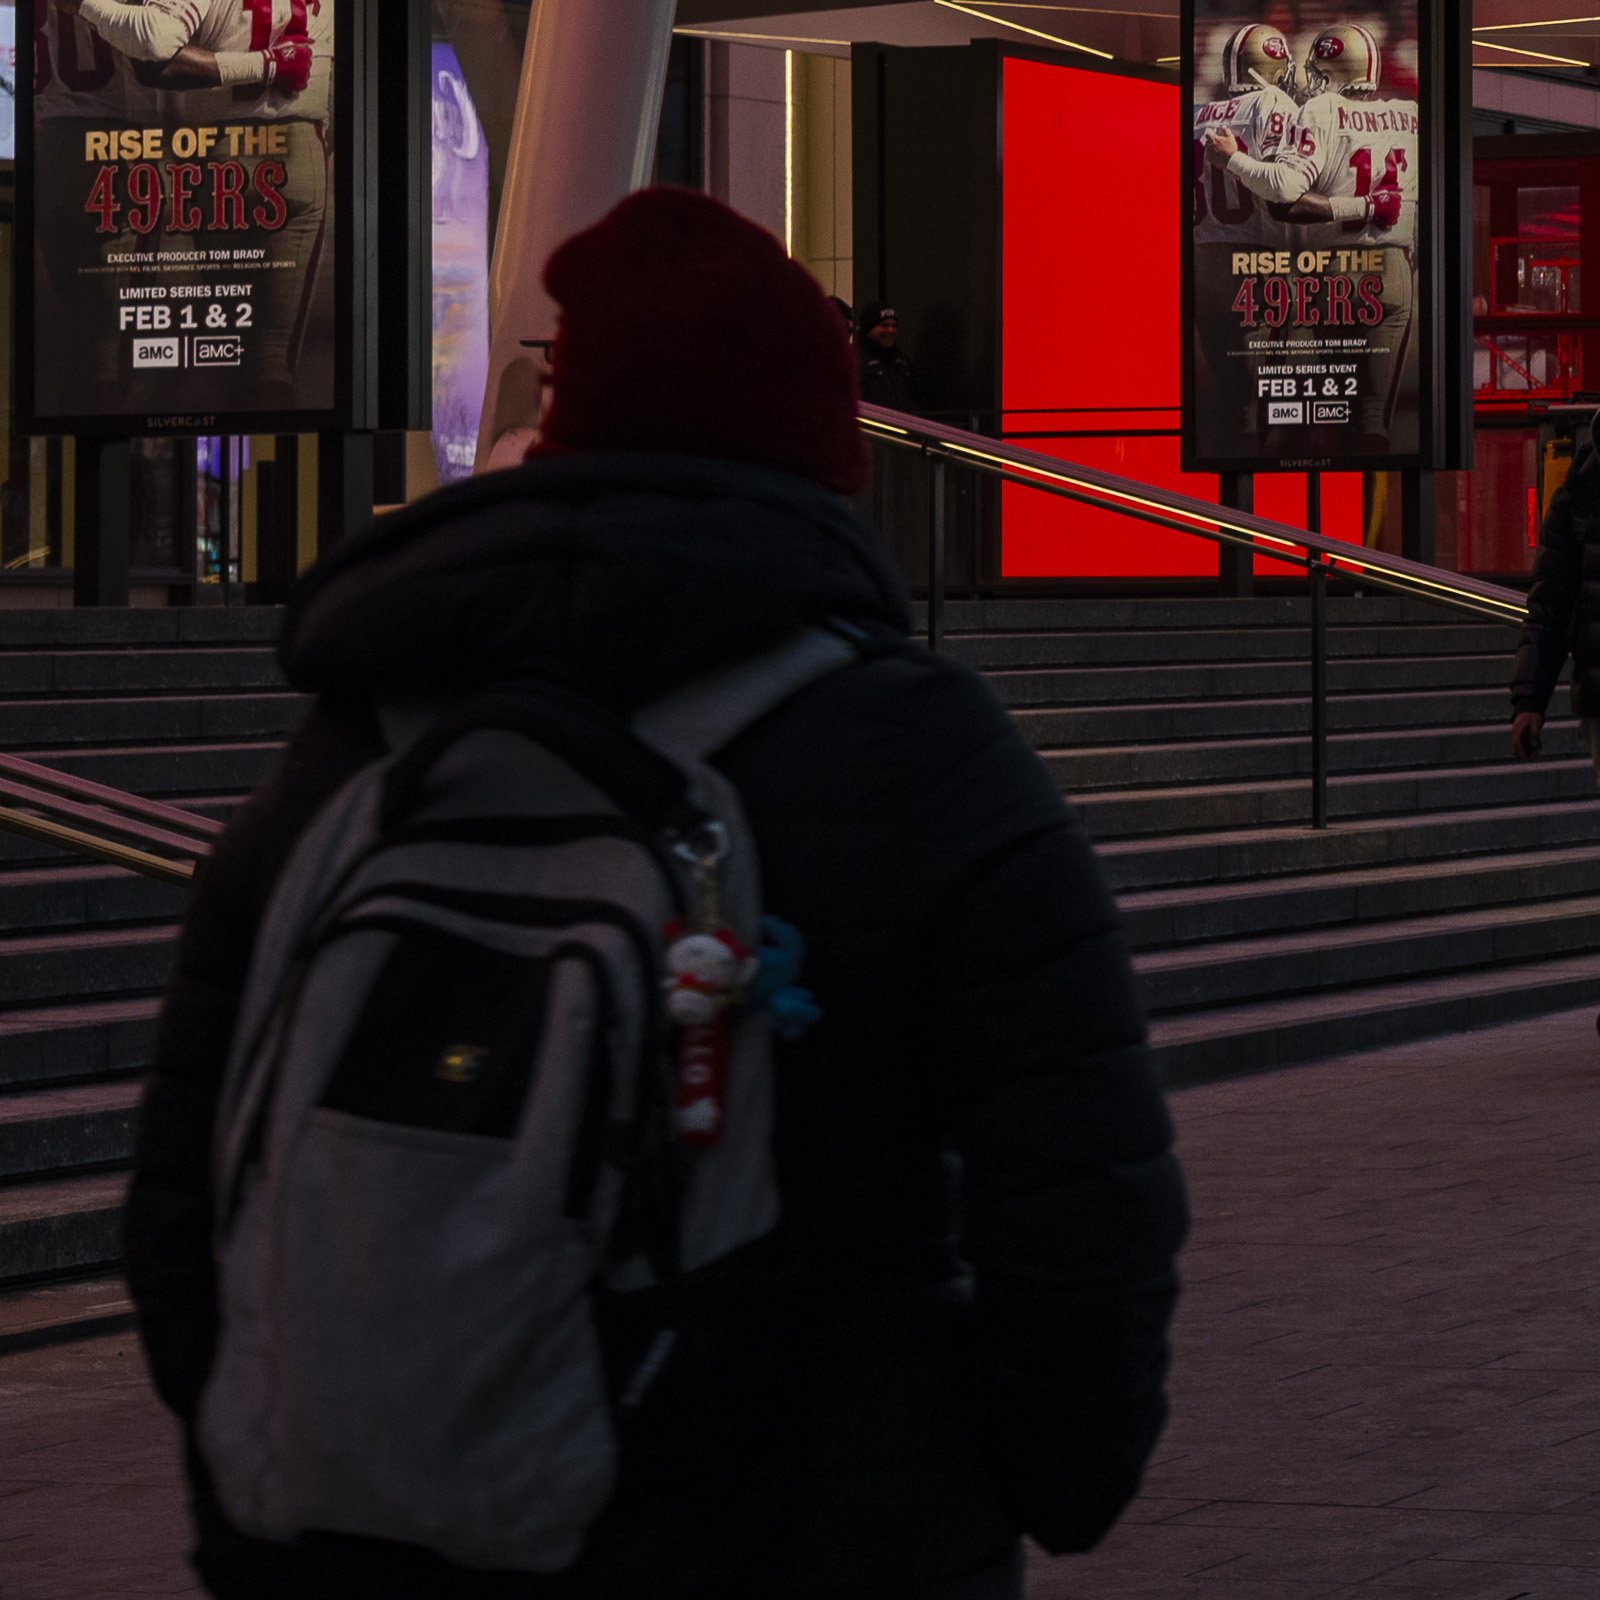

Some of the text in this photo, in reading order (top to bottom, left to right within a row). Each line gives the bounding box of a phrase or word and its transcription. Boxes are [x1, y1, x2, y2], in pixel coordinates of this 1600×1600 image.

[1337, 107, 1419, 135] MONTANA
[85, 124, 289, 161] RISE OF THE
[84, 161, 287, 234] 49ERS
[107, 249, 266, 263] EXECUTIVE PRODUCER TOM BRADY
[1232, 250, 1384, 275] RISE OF THE
[119, 284, 252, 300] LIMITED SERIES EVENT
[1231, 275, 1384, 328] 49ERS
[119, 302, 253, 331] FEB 1 & 2
[1249, 338, 1367, 349] EXECUTIVE PRODUCER TOM BRADY
[1258, 364, 1357, 375] LIMITED SERIES EVENT
[1258, 377, 1358, 398] FEB 1 & 2
